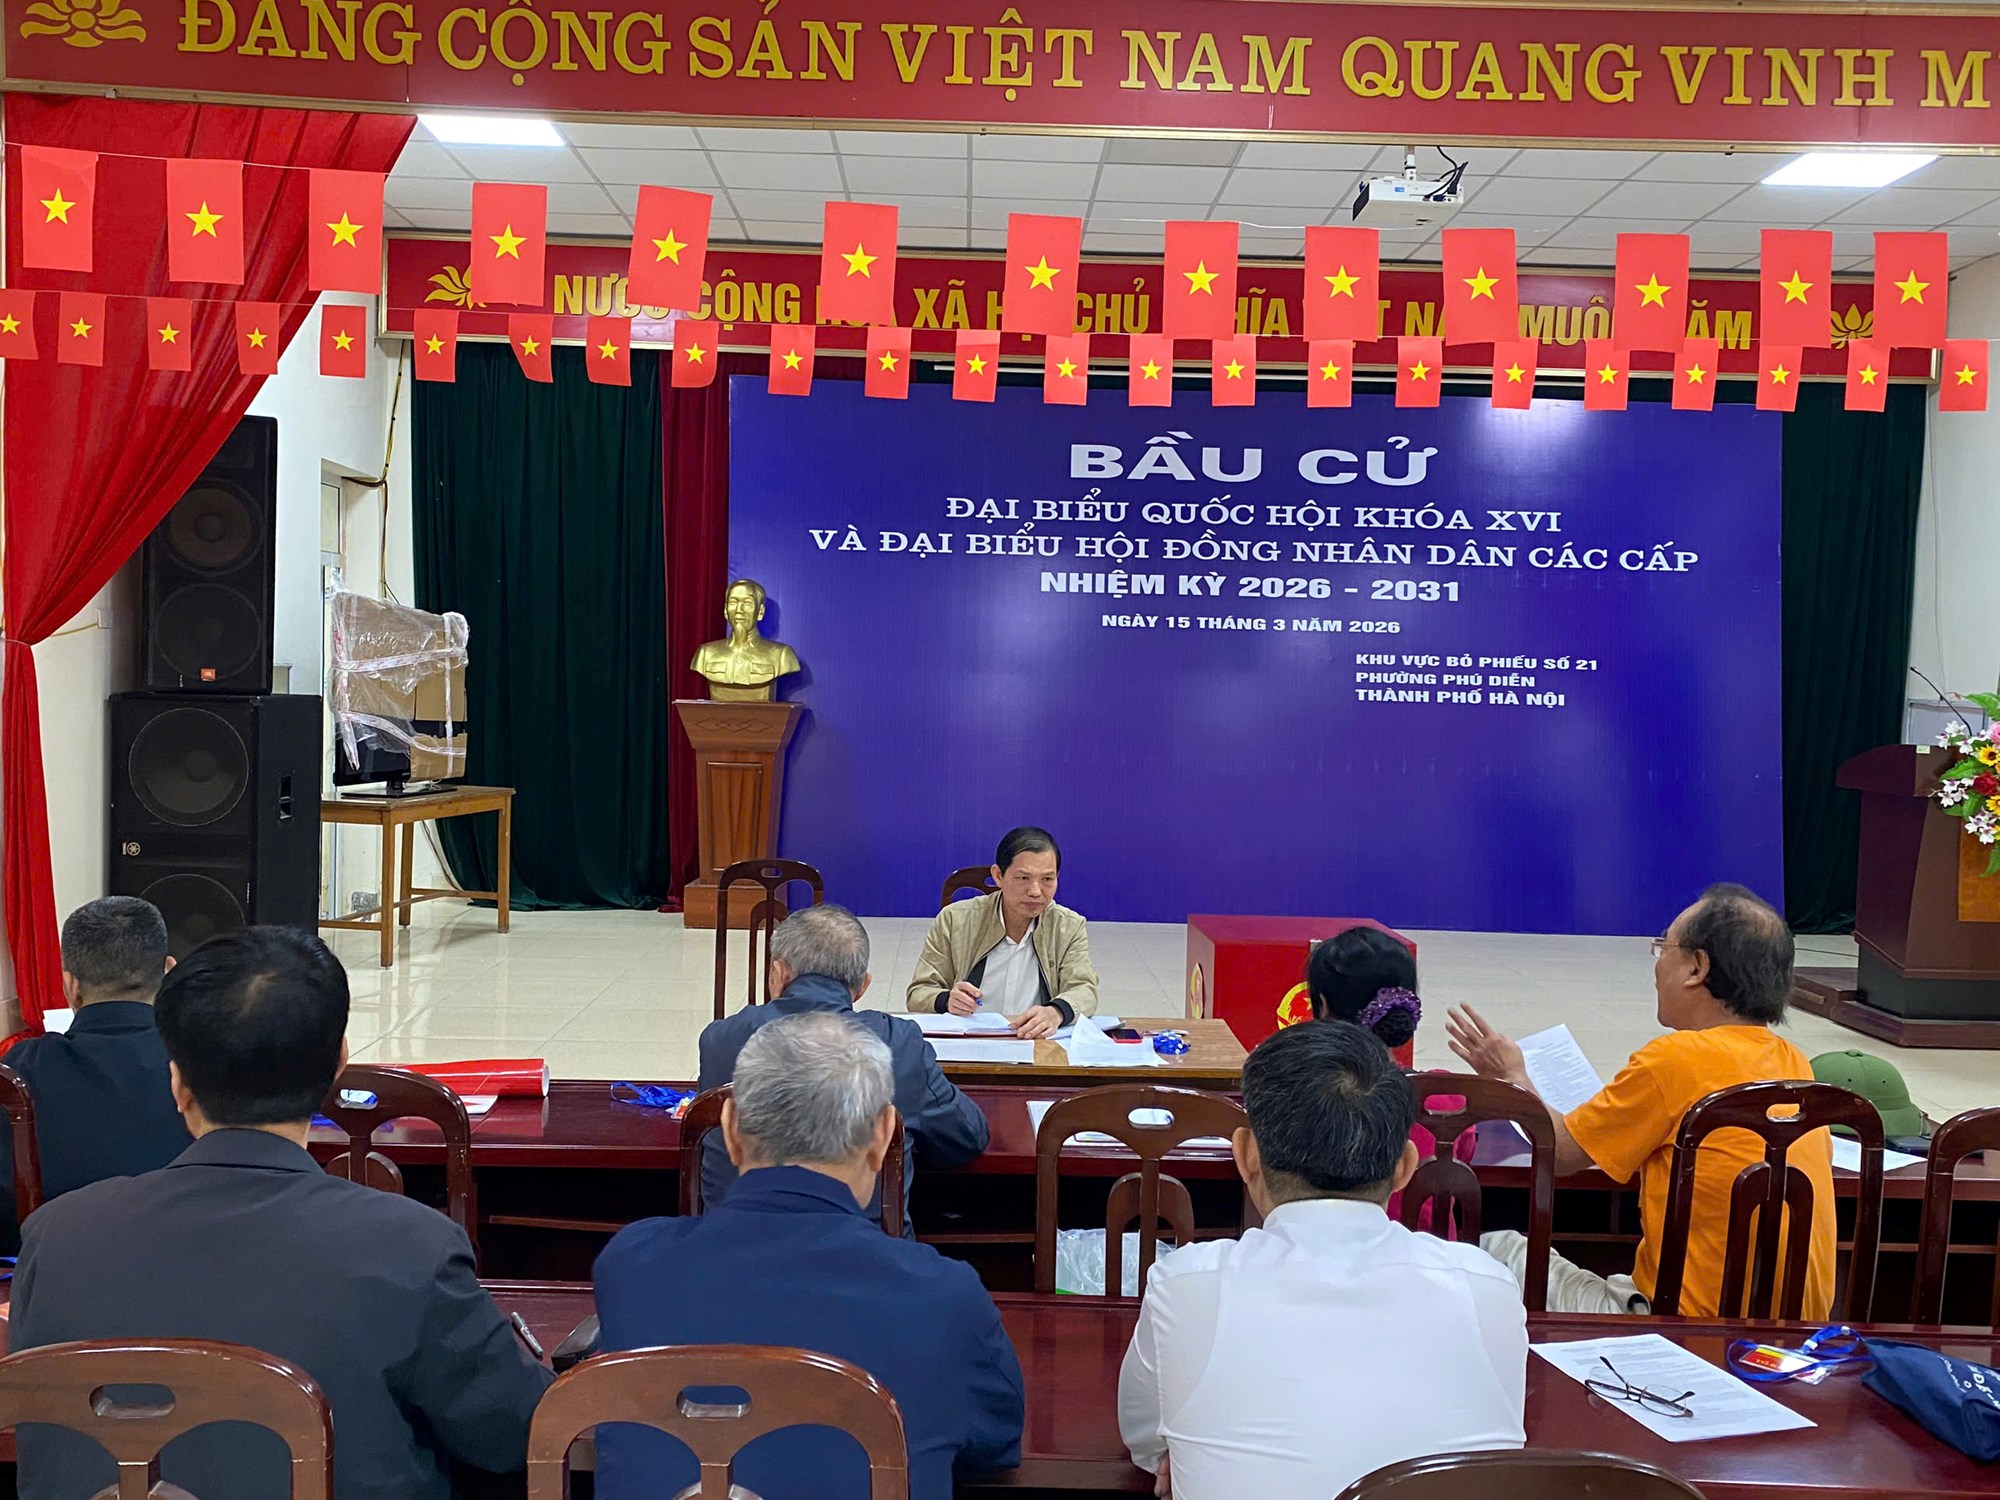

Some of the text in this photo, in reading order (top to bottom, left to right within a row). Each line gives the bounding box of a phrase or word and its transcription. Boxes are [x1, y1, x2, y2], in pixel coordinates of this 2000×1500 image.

[437, 0, 672, 87] CỘNG
[880, 7, 1093, 102] VIỆT
[1119, 29, 1313, 96] NAM
[1341, 36, 1642, 103] QUANG
[1660, 46, 1895, 107] VINH
[912, 278, 970, 329] XÃ
[1073, 277, 1150, 334] CHỦ
[1518, 295, 1615, 346] MUÔ
[1685, 299, 1753, 350] ĂM
[1070, 431, 1439, 486] BẦU CỬ
[946, 487, 1562, 532] ĐẠI BIỂU QUỐC HỘI KHÓA XVI
[808, 521, 1699, 572] VÀ ĐẠI BIỂU HỘI ĐỒNG NHÂN DÂN CÁC CẤP
[1040, 569, 1165, 599] NHIỆM
[1178, 571, 1227, 596] KỲ
[1238, 576, 1331, 599] 2026
[1370, 579, 1459, 602] 2031
[1101, 613, 1401, 634] NGÀY 15 THÁNG 3 NĂM 2026
[1355, 653, 1597, 671] KHU VỰC BỎ PHIẾU SỐ 21
[1355, 670, 1535, 687] PHƯỜNG PHÚ DIỄN
[1354, 687, 1565, 709] THÀNH PHỐ HÀ NỘI
